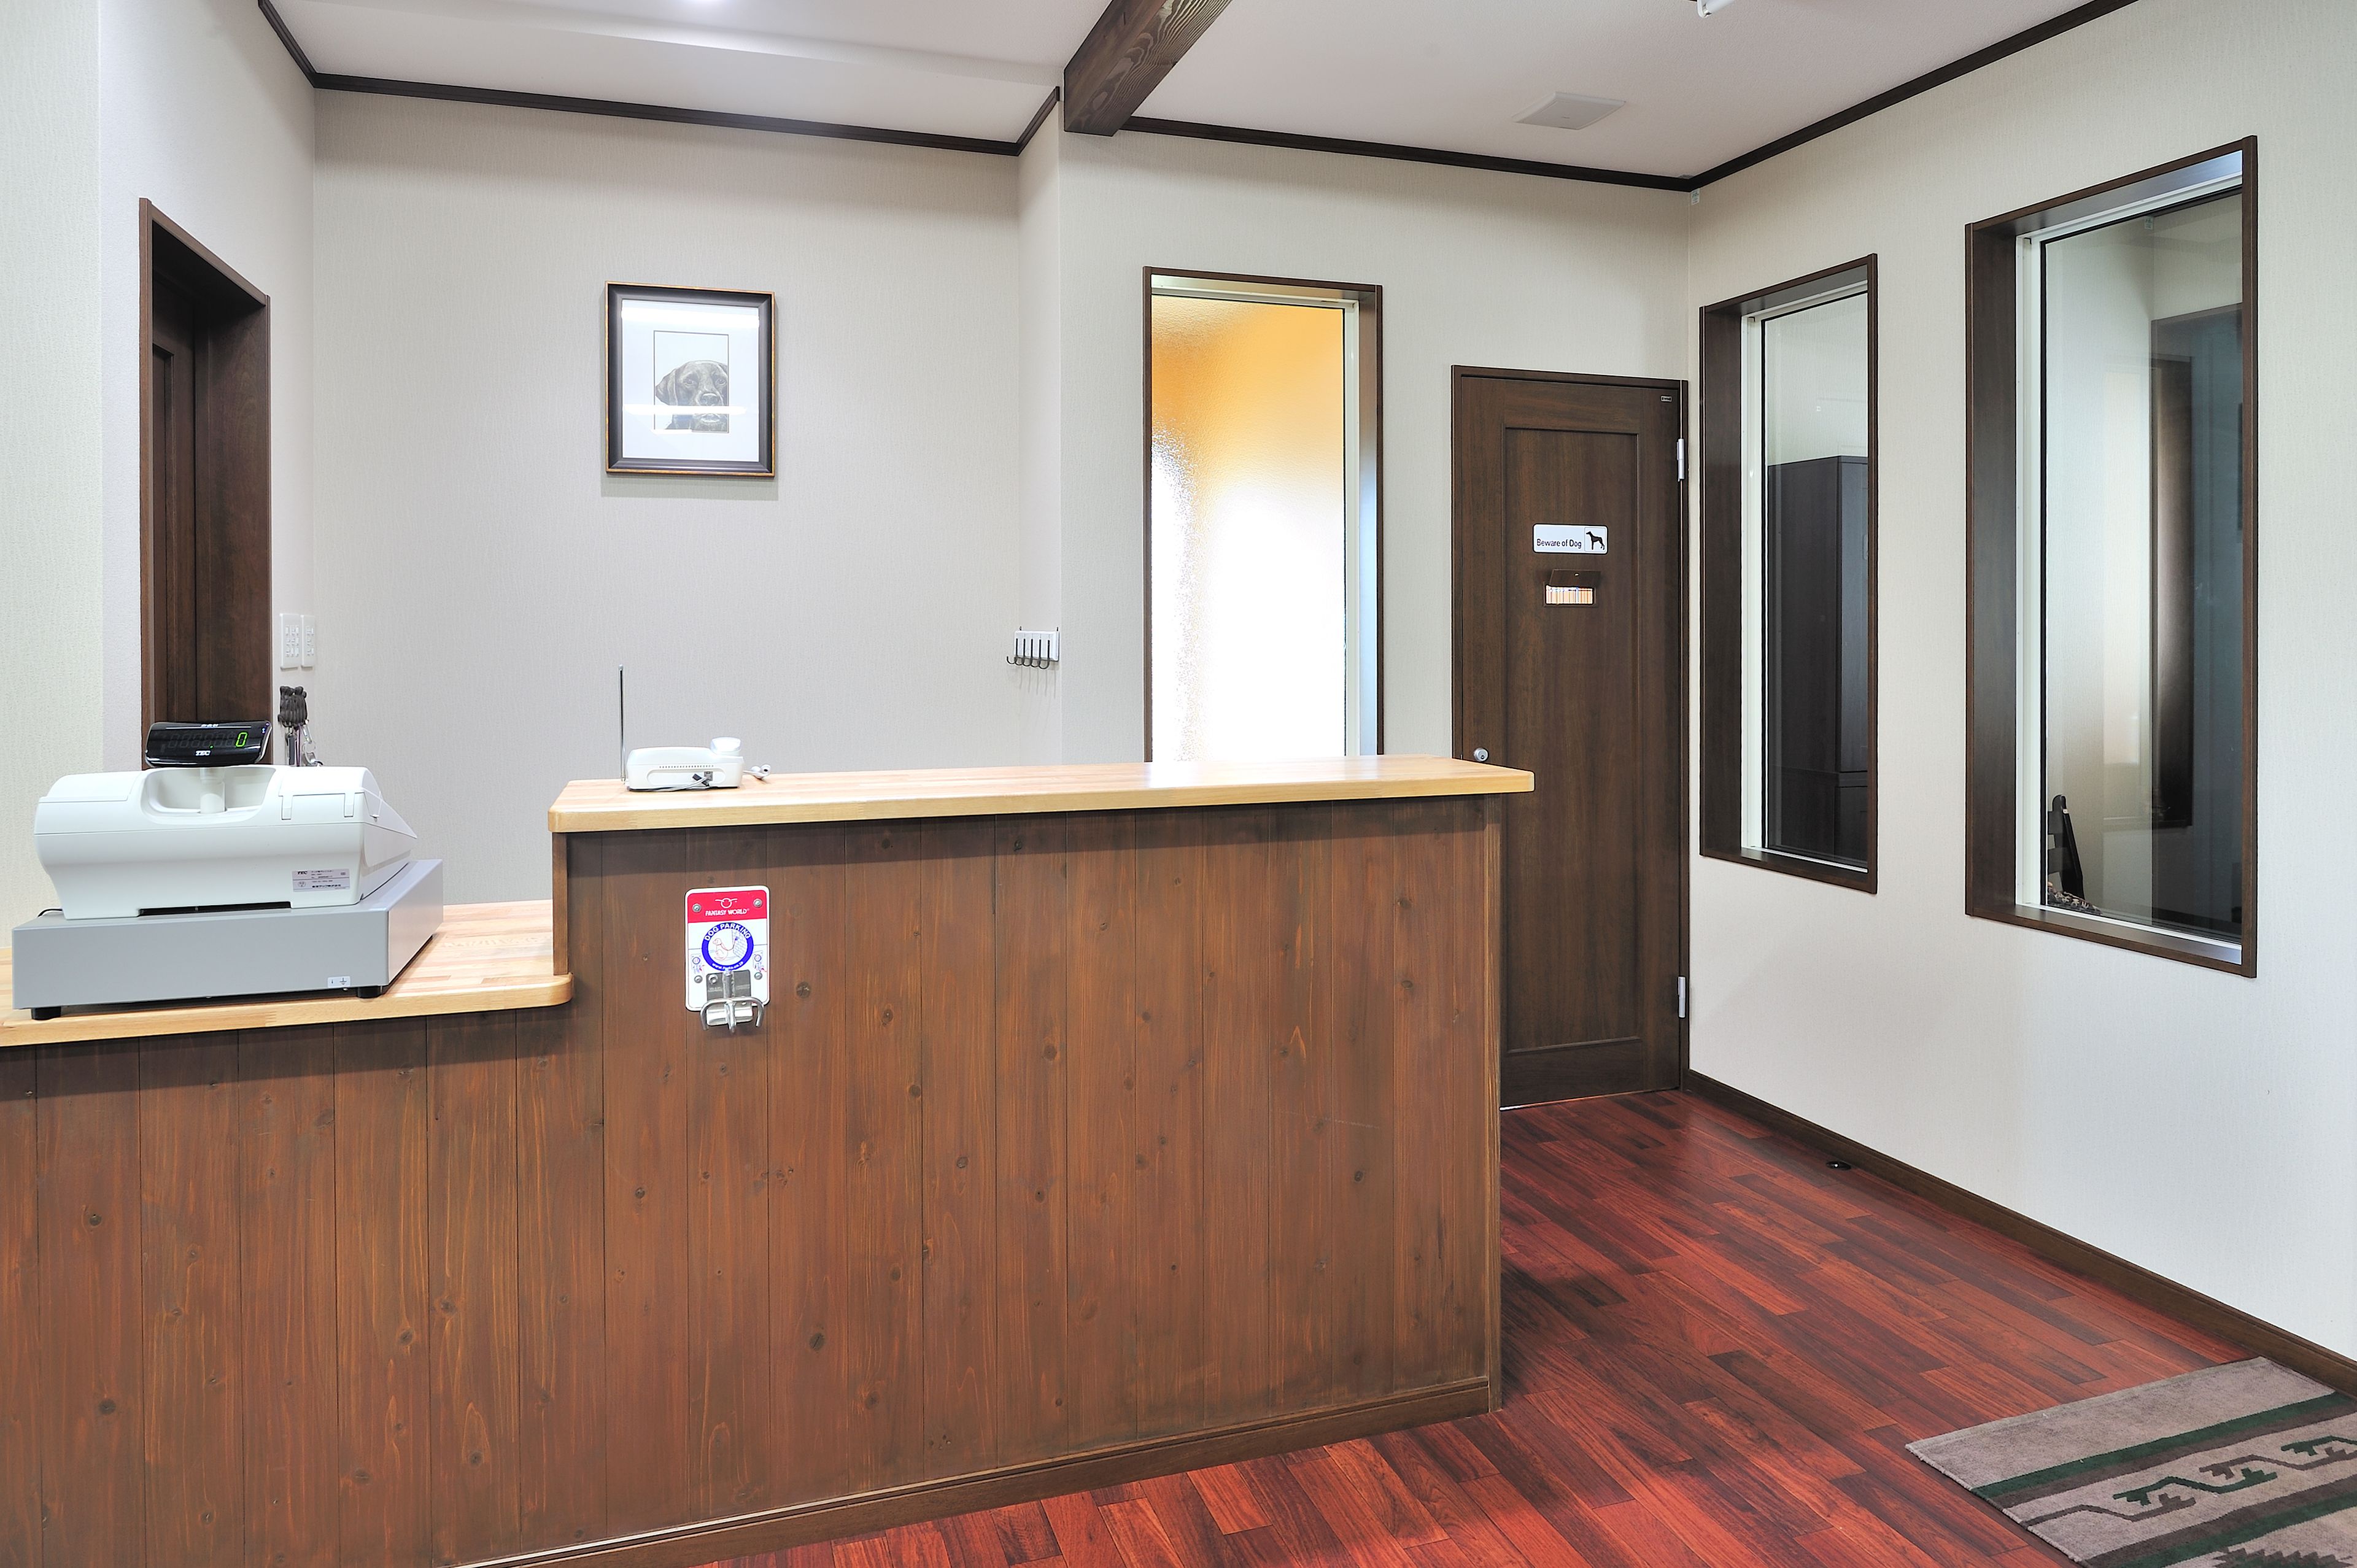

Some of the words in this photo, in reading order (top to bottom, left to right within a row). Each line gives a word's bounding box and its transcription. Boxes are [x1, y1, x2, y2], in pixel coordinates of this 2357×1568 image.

[1569, 539, 1582, 549] Dog
[704, 926, 719, 941] DOG
[719, 923, 751, 939] PARKING
